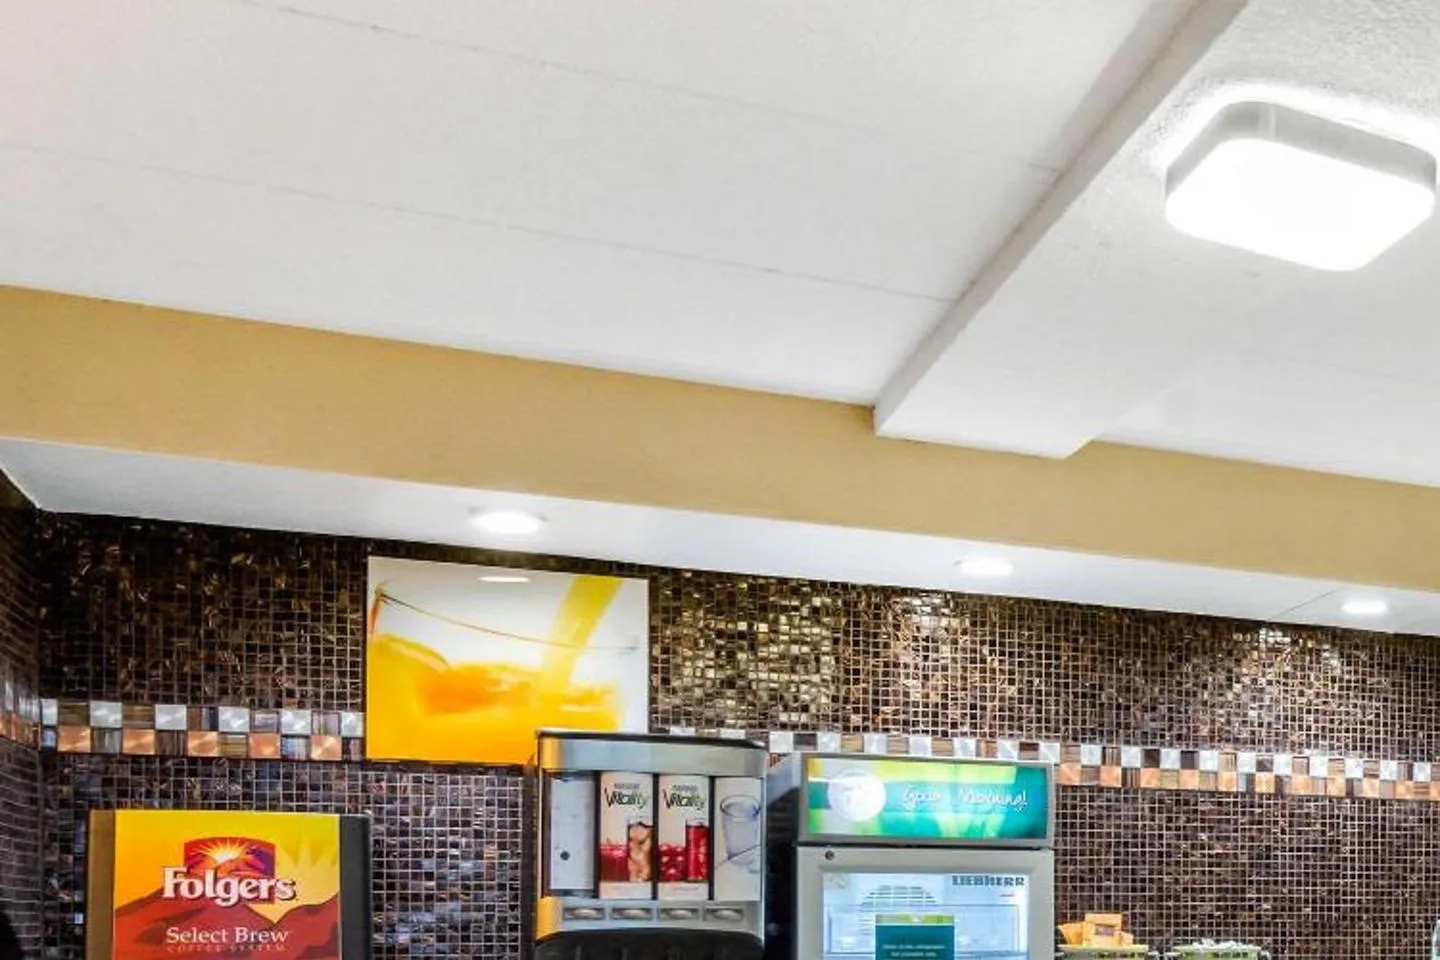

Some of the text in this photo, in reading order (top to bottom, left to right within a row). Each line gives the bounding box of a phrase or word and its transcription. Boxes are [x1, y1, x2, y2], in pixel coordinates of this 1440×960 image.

[604, 787, 646, 809] Vitality
[663, 789, 705, 811] Vitality
[162, 865, 297, 907] Folgers
[951, 875, 1025, 887] LIEBHERR
[166, 926, 289, 944] Select Brew
